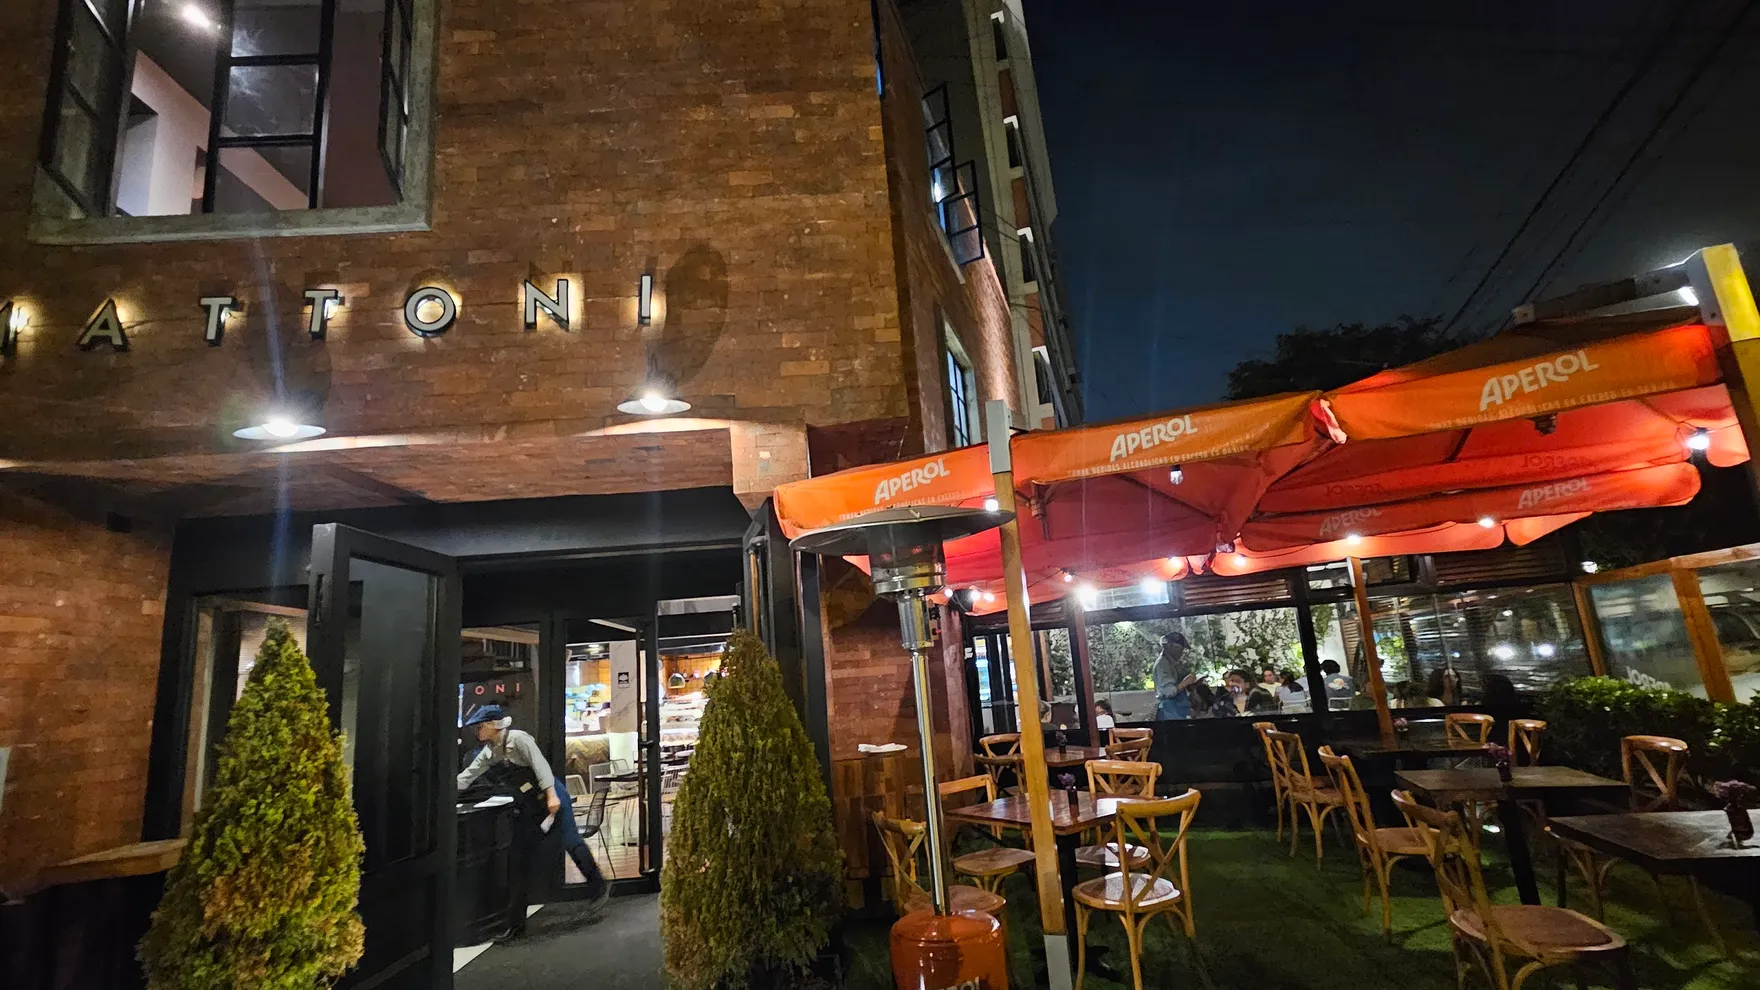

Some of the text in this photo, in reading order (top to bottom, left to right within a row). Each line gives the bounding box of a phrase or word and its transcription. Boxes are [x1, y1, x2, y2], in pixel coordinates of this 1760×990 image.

[1479, 350, 1599, 411] APEROL
[1109, 414, 1199, 462] APEROL
[874, 457, 951, 505] APEROL
[1517, 477, 1592, 510] APEROL
[1320, 507, 1382, 536] APEROL
